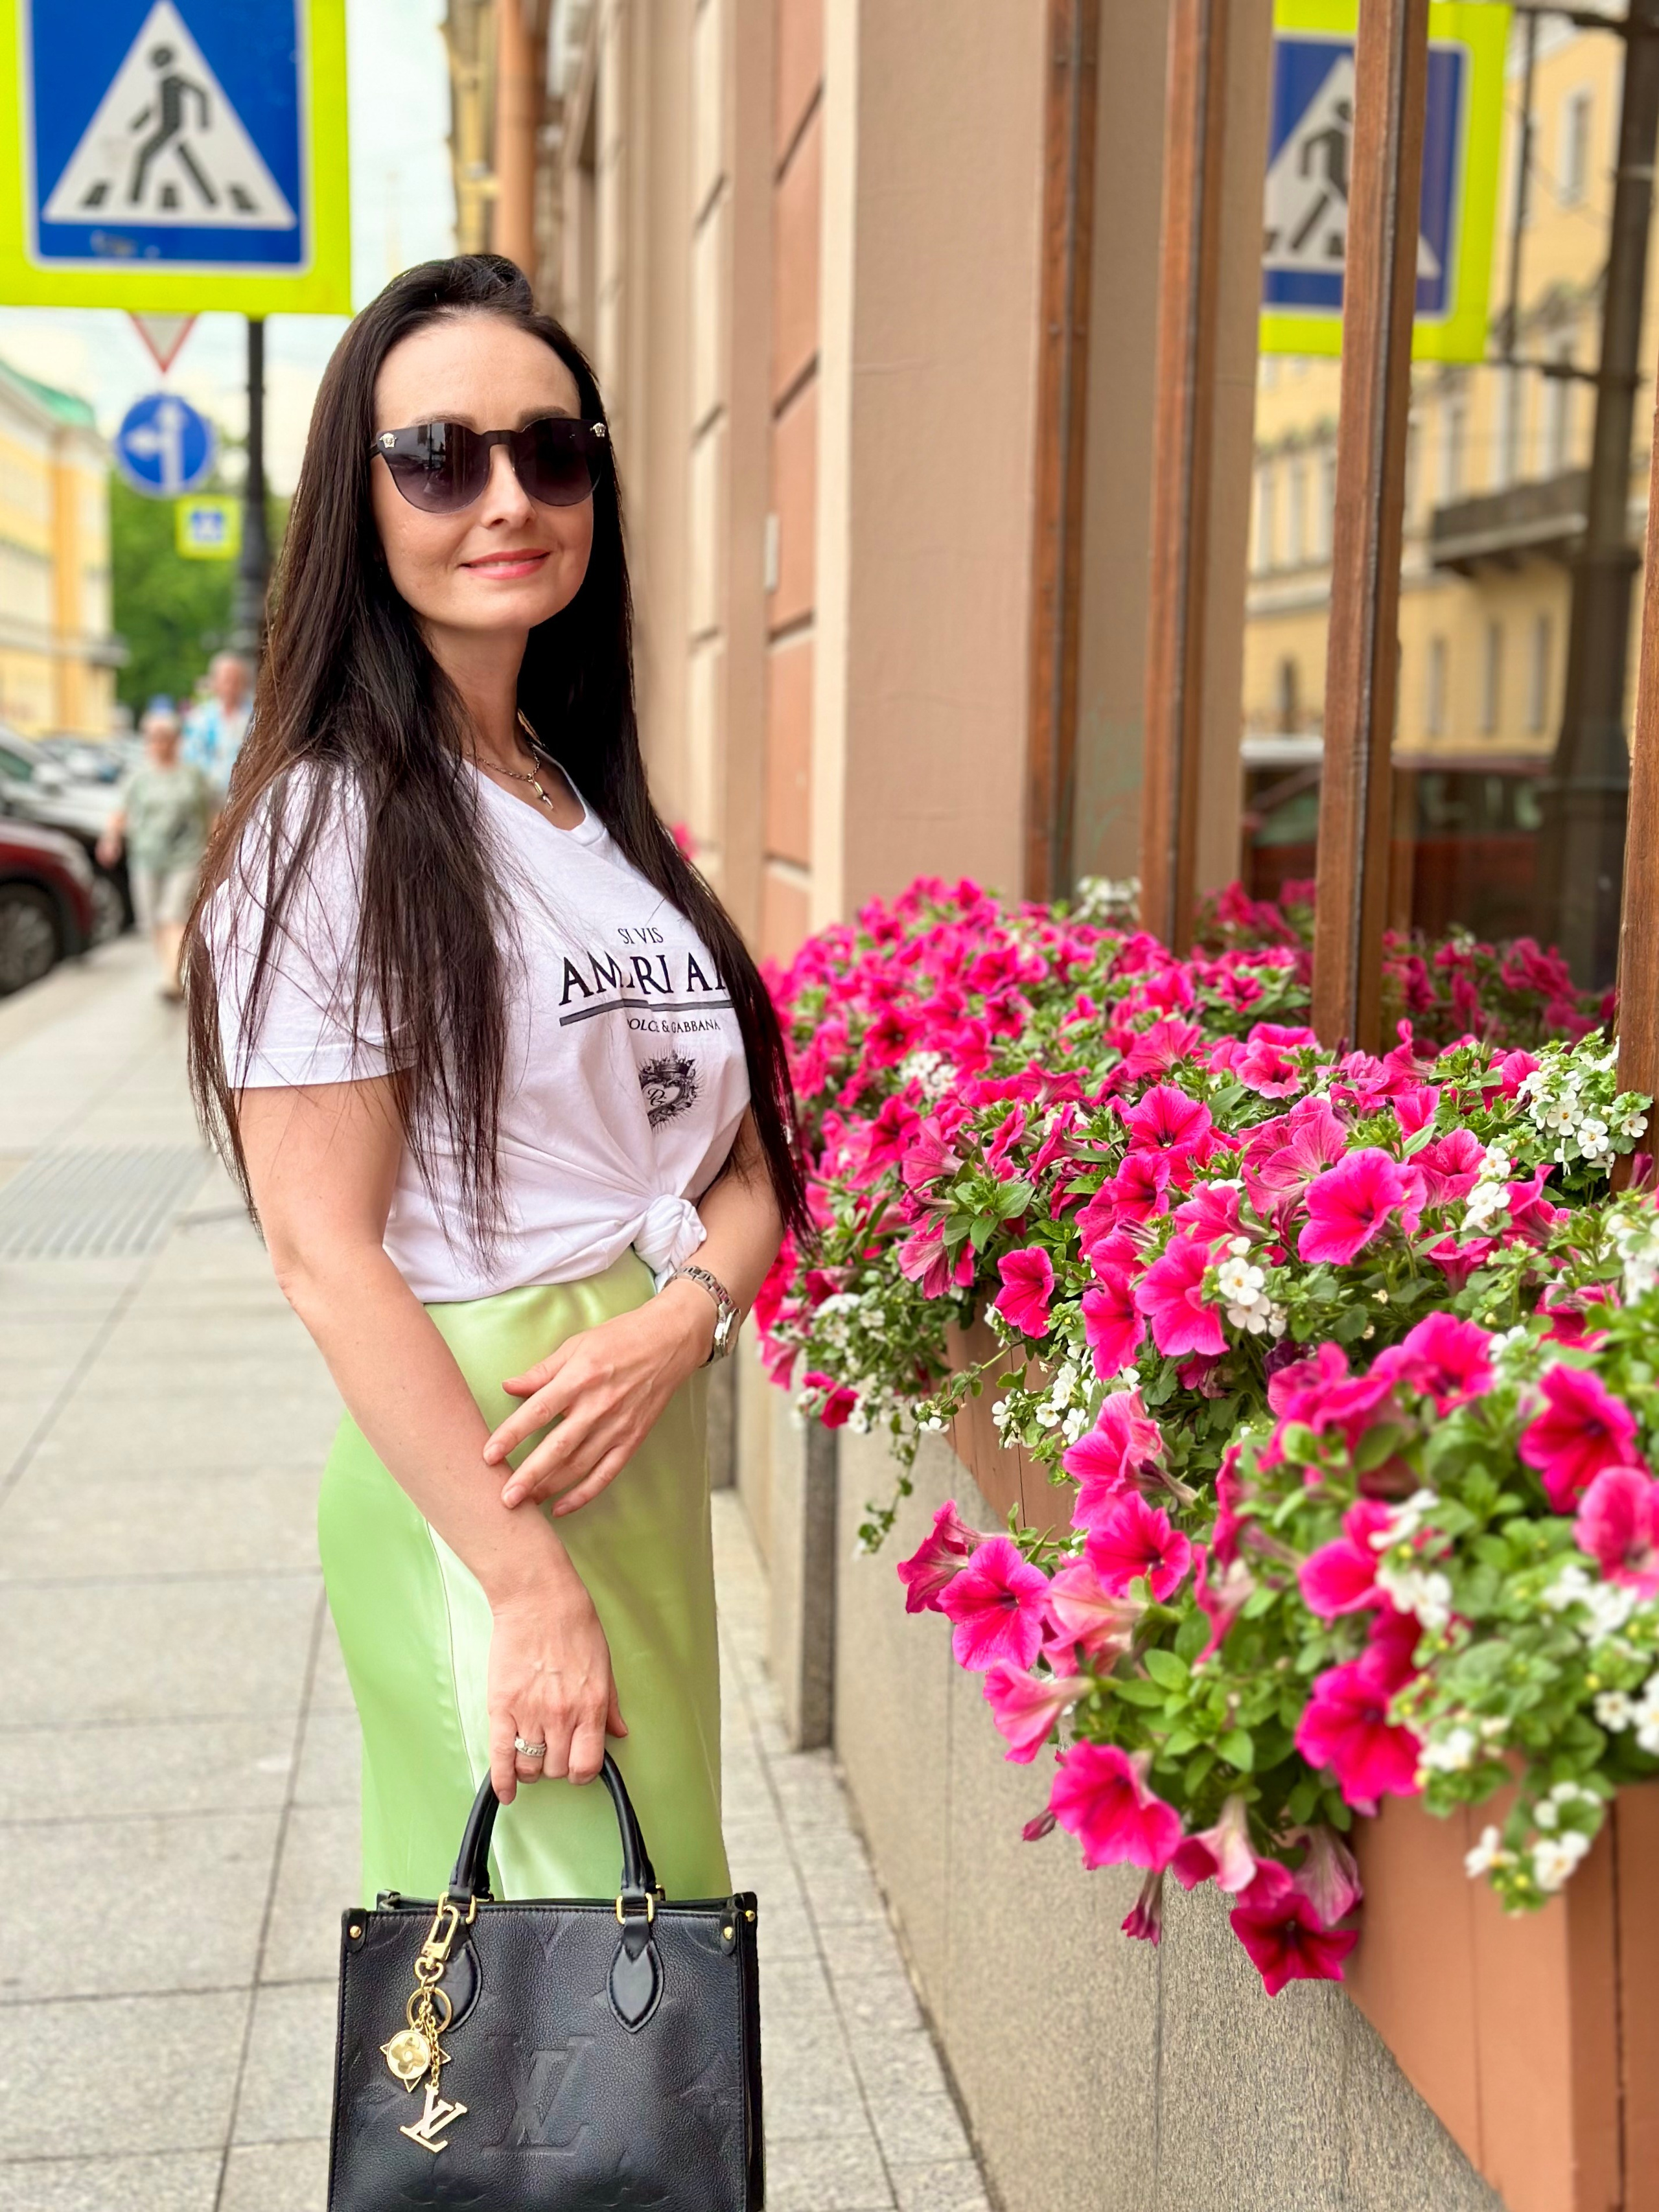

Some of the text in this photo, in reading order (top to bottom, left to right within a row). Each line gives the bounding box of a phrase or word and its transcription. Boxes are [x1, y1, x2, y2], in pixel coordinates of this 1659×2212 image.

[618, 927, 664, 944] SI VIS
[662, 1020, 670, 1033] &
[671, 1019, 721, 1033] GABBANA
